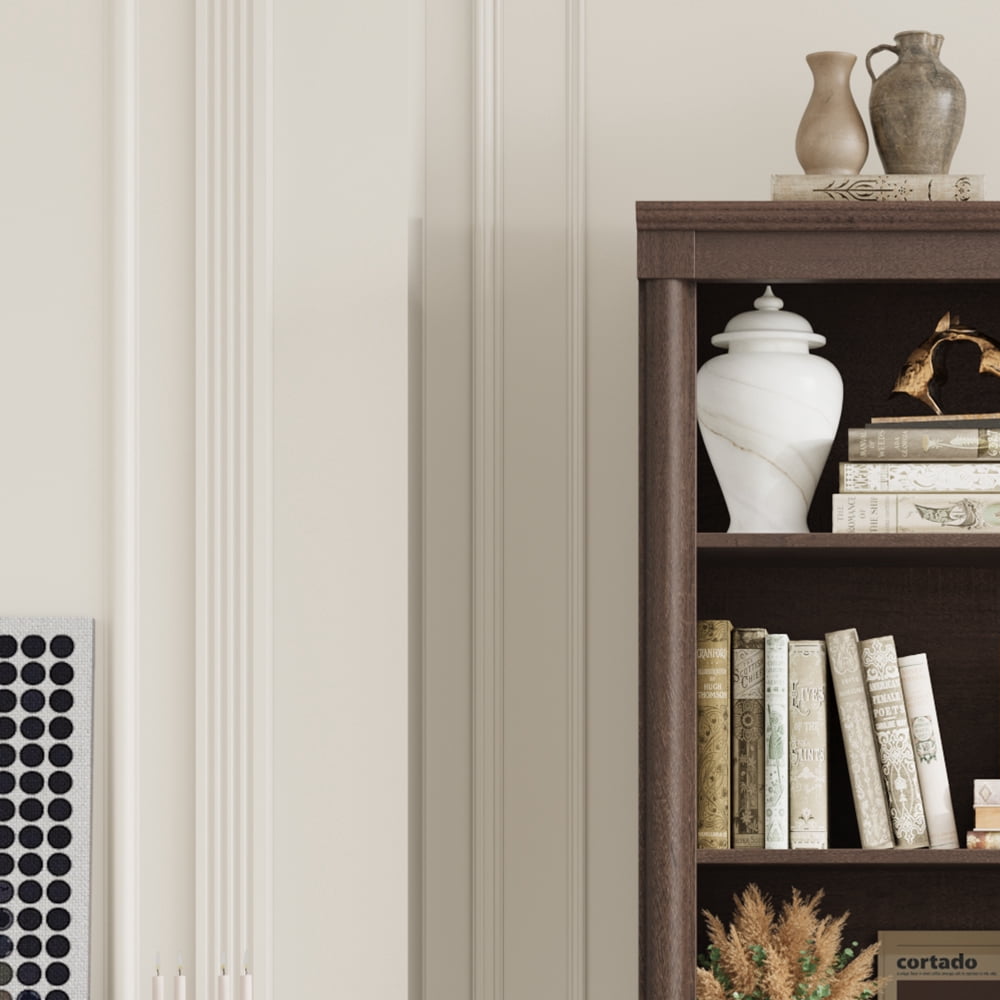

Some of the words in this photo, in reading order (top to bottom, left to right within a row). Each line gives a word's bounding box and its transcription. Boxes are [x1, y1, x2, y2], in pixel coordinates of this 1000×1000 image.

[847, 497, 856, 532] ROMANCE
[873, 691, 903, 704] FEMALE
[874, 704, 906, 718] POETS
[896, 953, 977, 969] cortado
